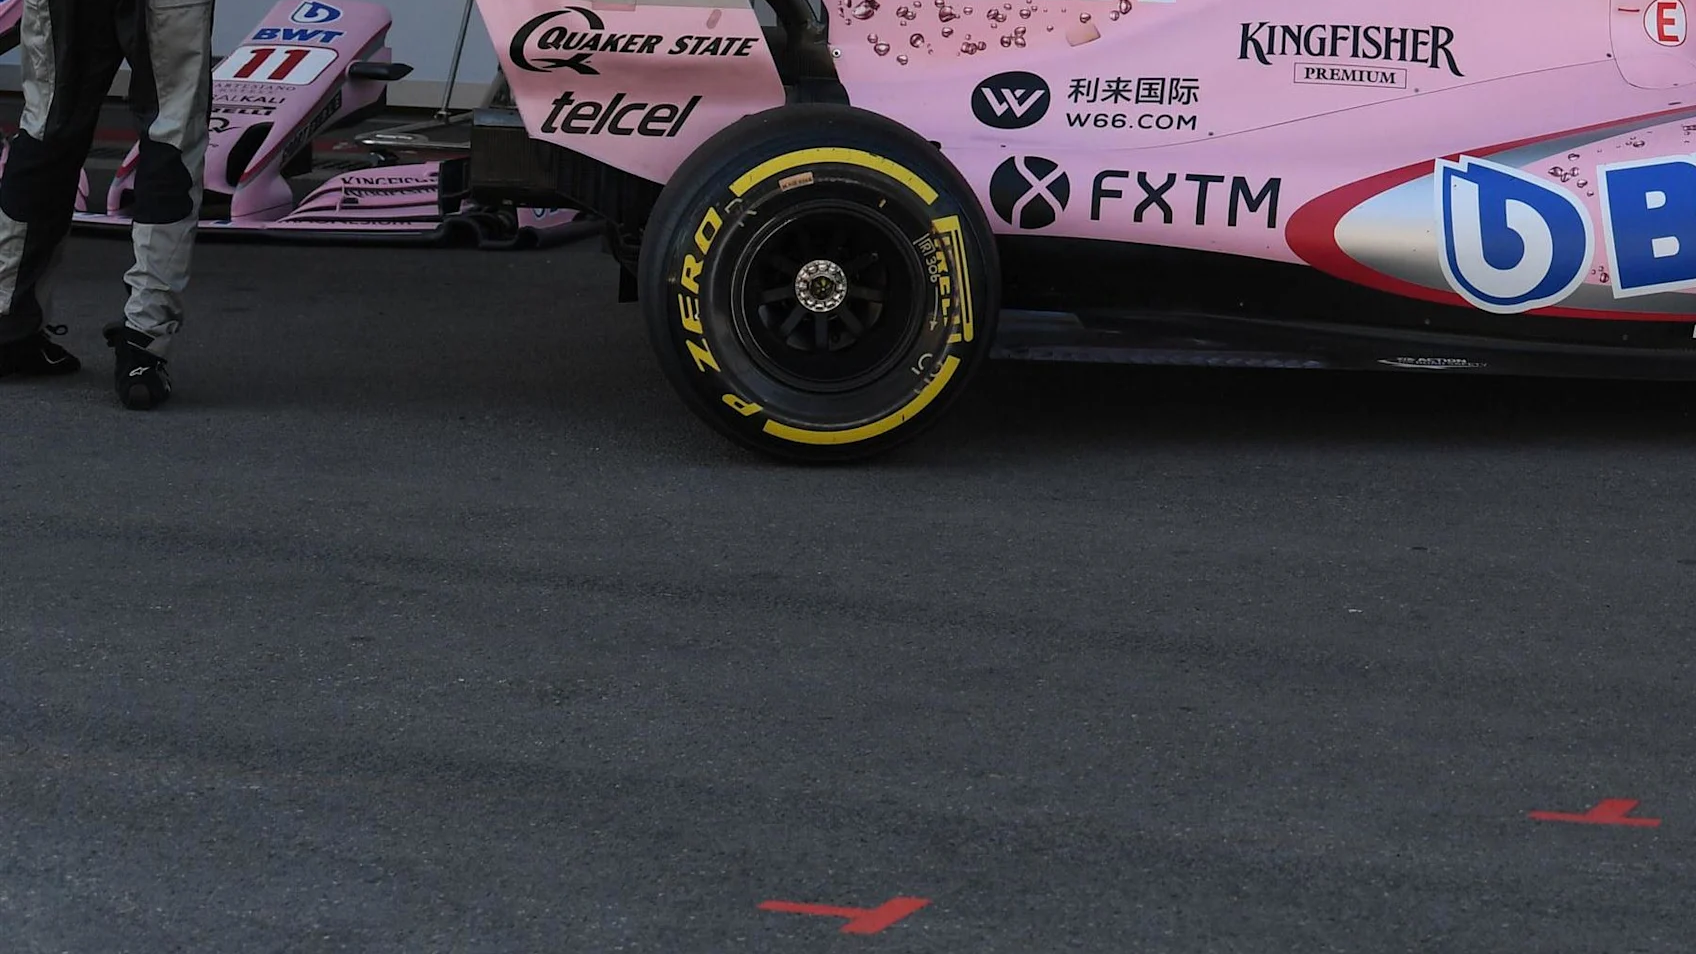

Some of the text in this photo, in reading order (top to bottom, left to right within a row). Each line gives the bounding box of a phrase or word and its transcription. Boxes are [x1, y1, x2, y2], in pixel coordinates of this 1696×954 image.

[251, 27, 345, 44] BWT
[1656, 2, 1679, 43] E
[537, 26, 760, 57] QUAKER STATE
[1238, 20, 1465, 77] KINGFISHER
[232, 48, 310, 81] 11
[1303, 66, 1397, 84] PREMIUM
[212, 93, 286, 104] ALKALI
[213, 82, 297, 91] ARTESIANO
[1067, 76, 1200, 104] 利来国际
[541, 91, 703, 137] telcel
[1066, 112, 1198, 130] W66.COM
[1090, 169, 1283, 229] FXTM
[677, 206, 723, 373] ZERO
